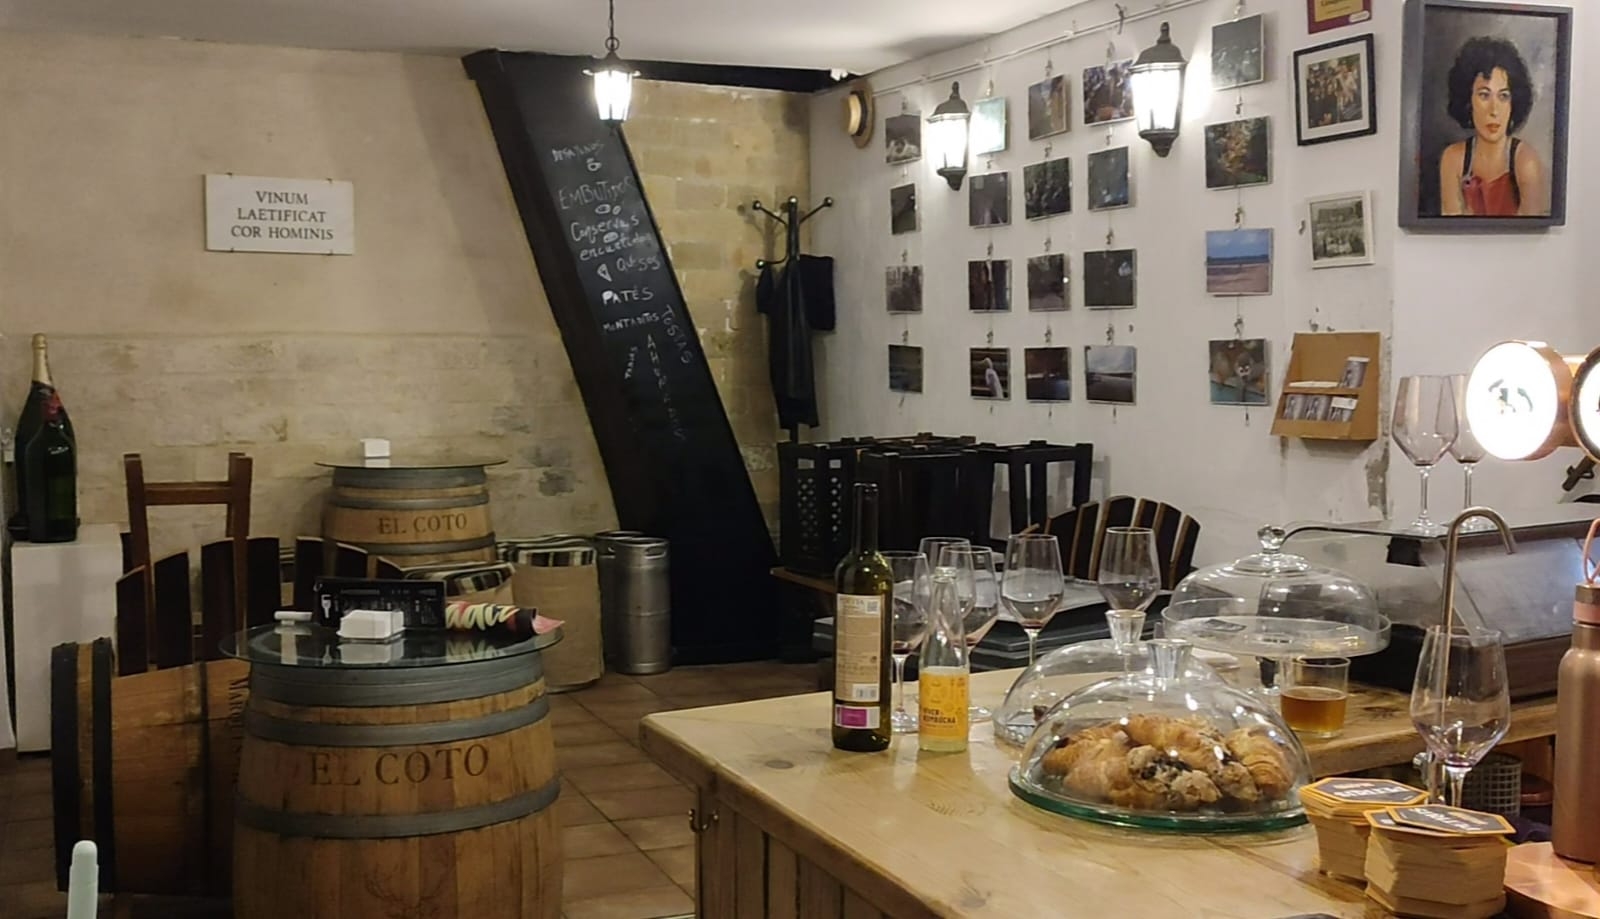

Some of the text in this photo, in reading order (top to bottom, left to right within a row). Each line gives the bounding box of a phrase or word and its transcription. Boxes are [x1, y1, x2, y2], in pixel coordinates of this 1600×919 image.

[255, 190, 309, 205] VINUM
[236, 207, 327, 223] LAETIFICAT
[230, 225, 334, 241] COR HOMINIS
[377, 512, 468, 535] EL COTO
[309, 743, 490, 786] EL COTO
